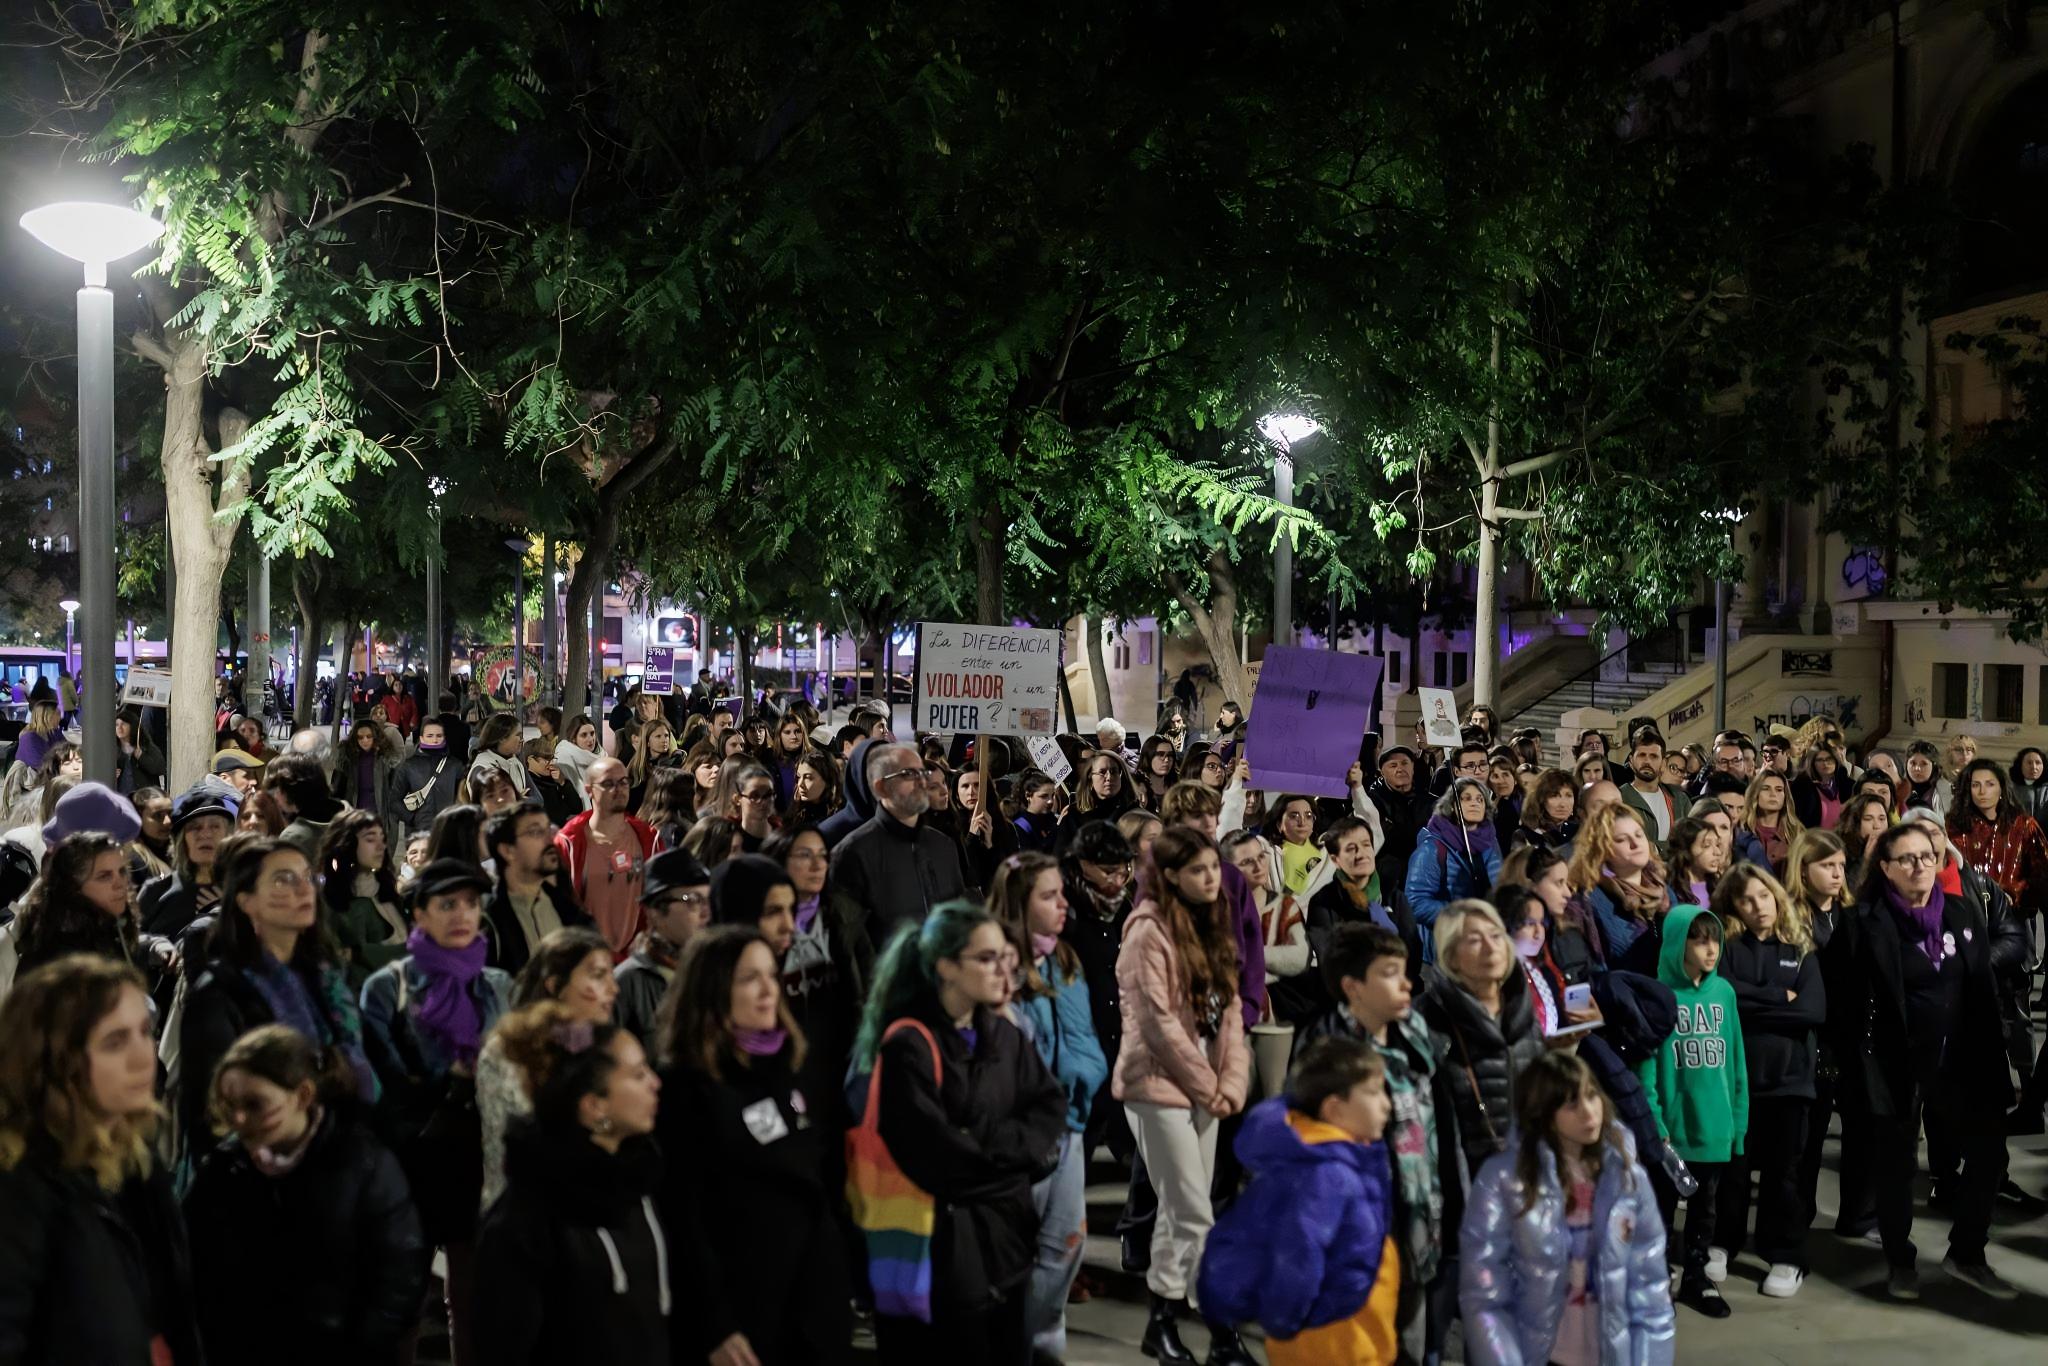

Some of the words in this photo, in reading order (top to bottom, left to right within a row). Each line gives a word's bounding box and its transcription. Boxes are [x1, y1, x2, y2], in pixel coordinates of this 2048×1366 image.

[929, 630, 951, 648] La
[961, 656, 993, 669] entre
[1000, 660, 1022, 670] un
[926, 672, 1004, 699] VIOLADOR
[1026, 685, 1045, 694] un
[929, 704, 979, 730] PUTER
[987, 701, 1003, 729] ?
[1675, 1003, 1724, 1036] GAP
